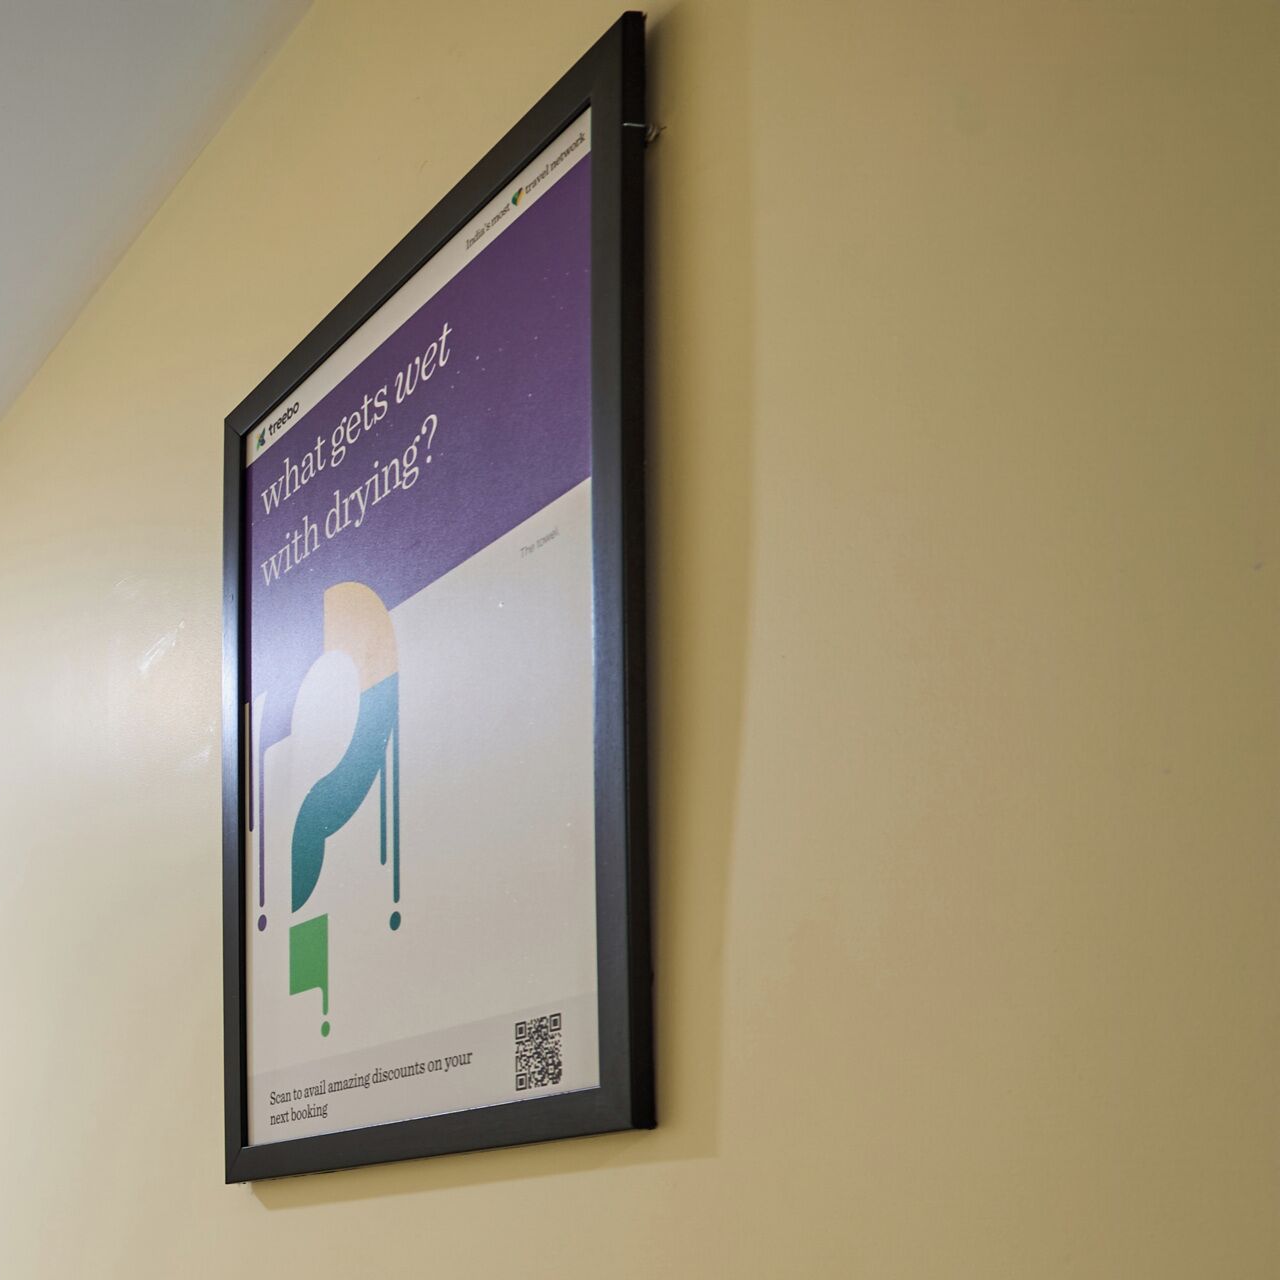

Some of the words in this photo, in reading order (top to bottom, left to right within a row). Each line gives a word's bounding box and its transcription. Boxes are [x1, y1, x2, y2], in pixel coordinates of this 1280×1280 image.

[491, 203, 511, 226] most
[525, 164, 550, 194] travel
[550, 132, 586, 171] network
[260, 435, 326, 515] what
[330, 384, 388, 468] gets
[394, 321, 453, 404] wet
[268, 401, 300, 436] treebo
[260, 514, 321, 587] with
[325, 413, 438, 539] drying?
[269, 1091, 292, 1105] Scan
[293, 1088, 303, 1101] to
[303, 1079, 326, 1098] avail
[327, 1072, 371, 1093] amazing
[371, 1062, 425, 1084] discounts
[427, 1058, 443, 1072] on
[444, 1052, 473, 1072] your
[270, 1111, 289, 1126] next
[290, 1103, 328, 1121] booking
